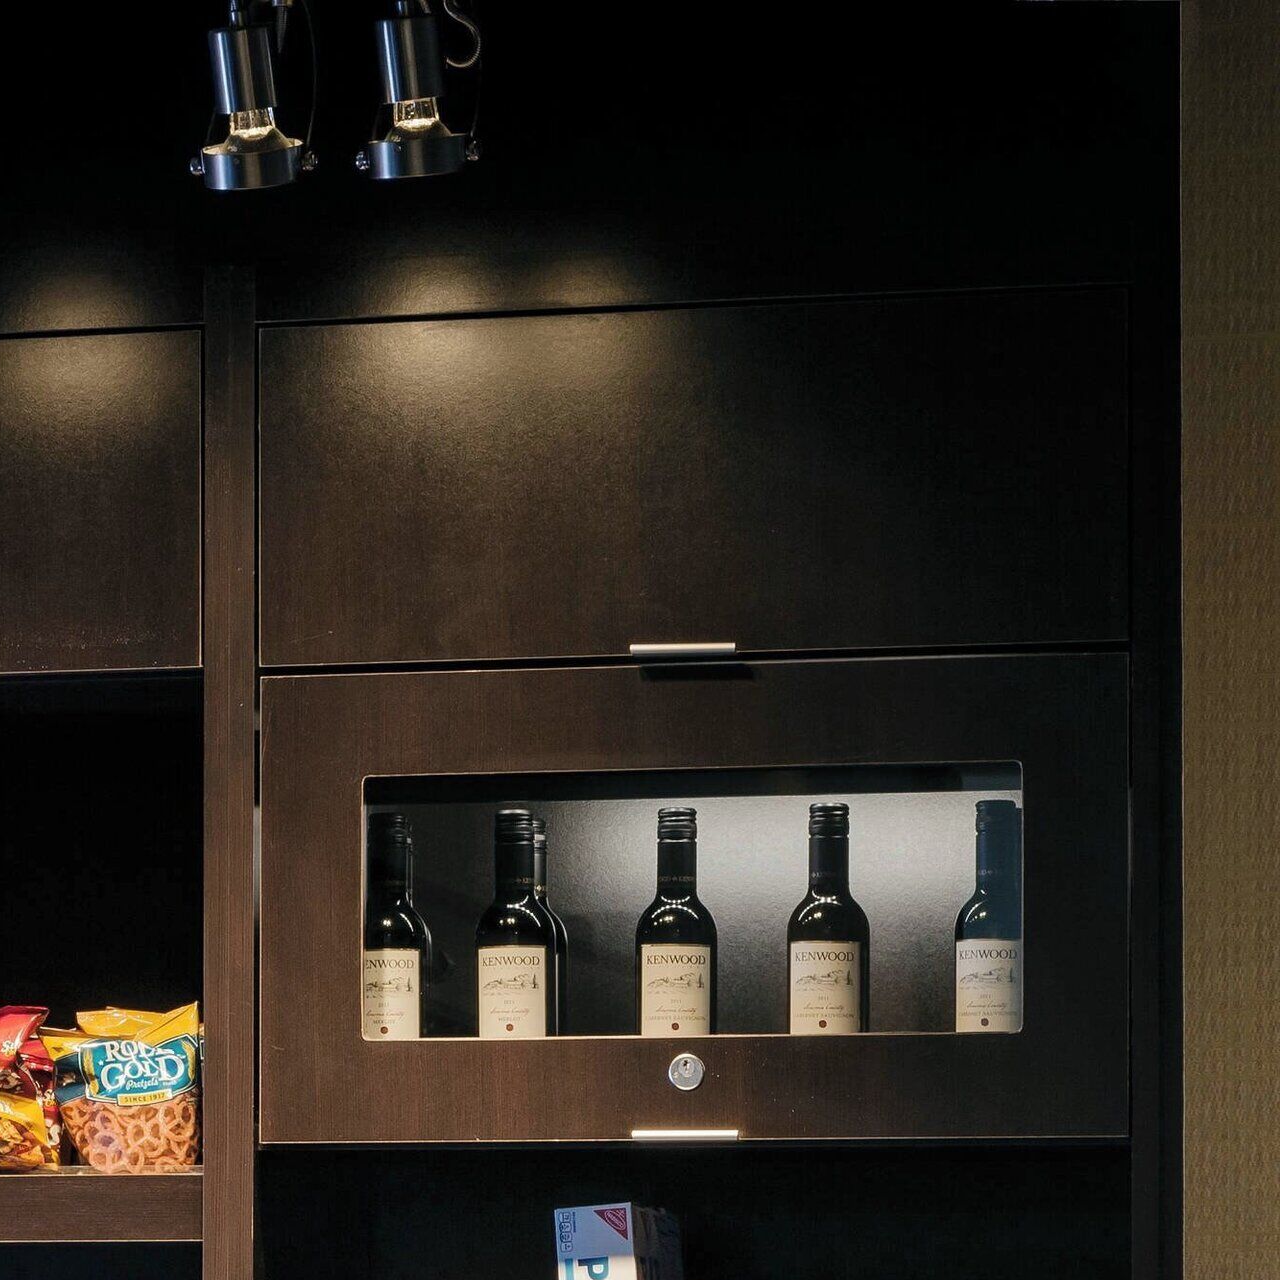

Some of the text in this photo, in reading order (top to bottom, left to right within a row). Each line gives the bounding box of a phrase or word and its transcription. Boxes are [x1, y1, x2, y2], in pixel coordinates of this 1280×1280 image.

[646, 954, 707, 966] KENWOOD
[795, 951, 855, 962] KENWOOD
[959, 949, 1018, 960] KENWOOD
[366, 958, 415, 970] ENWOOD
[481, 955, 541, 967] KENWOOD
[100, 1054, 185, 1091] GOLD
[125, 1077, 159, 1091] Pretzels
[124, 1094, 147, 1103] SINCE
